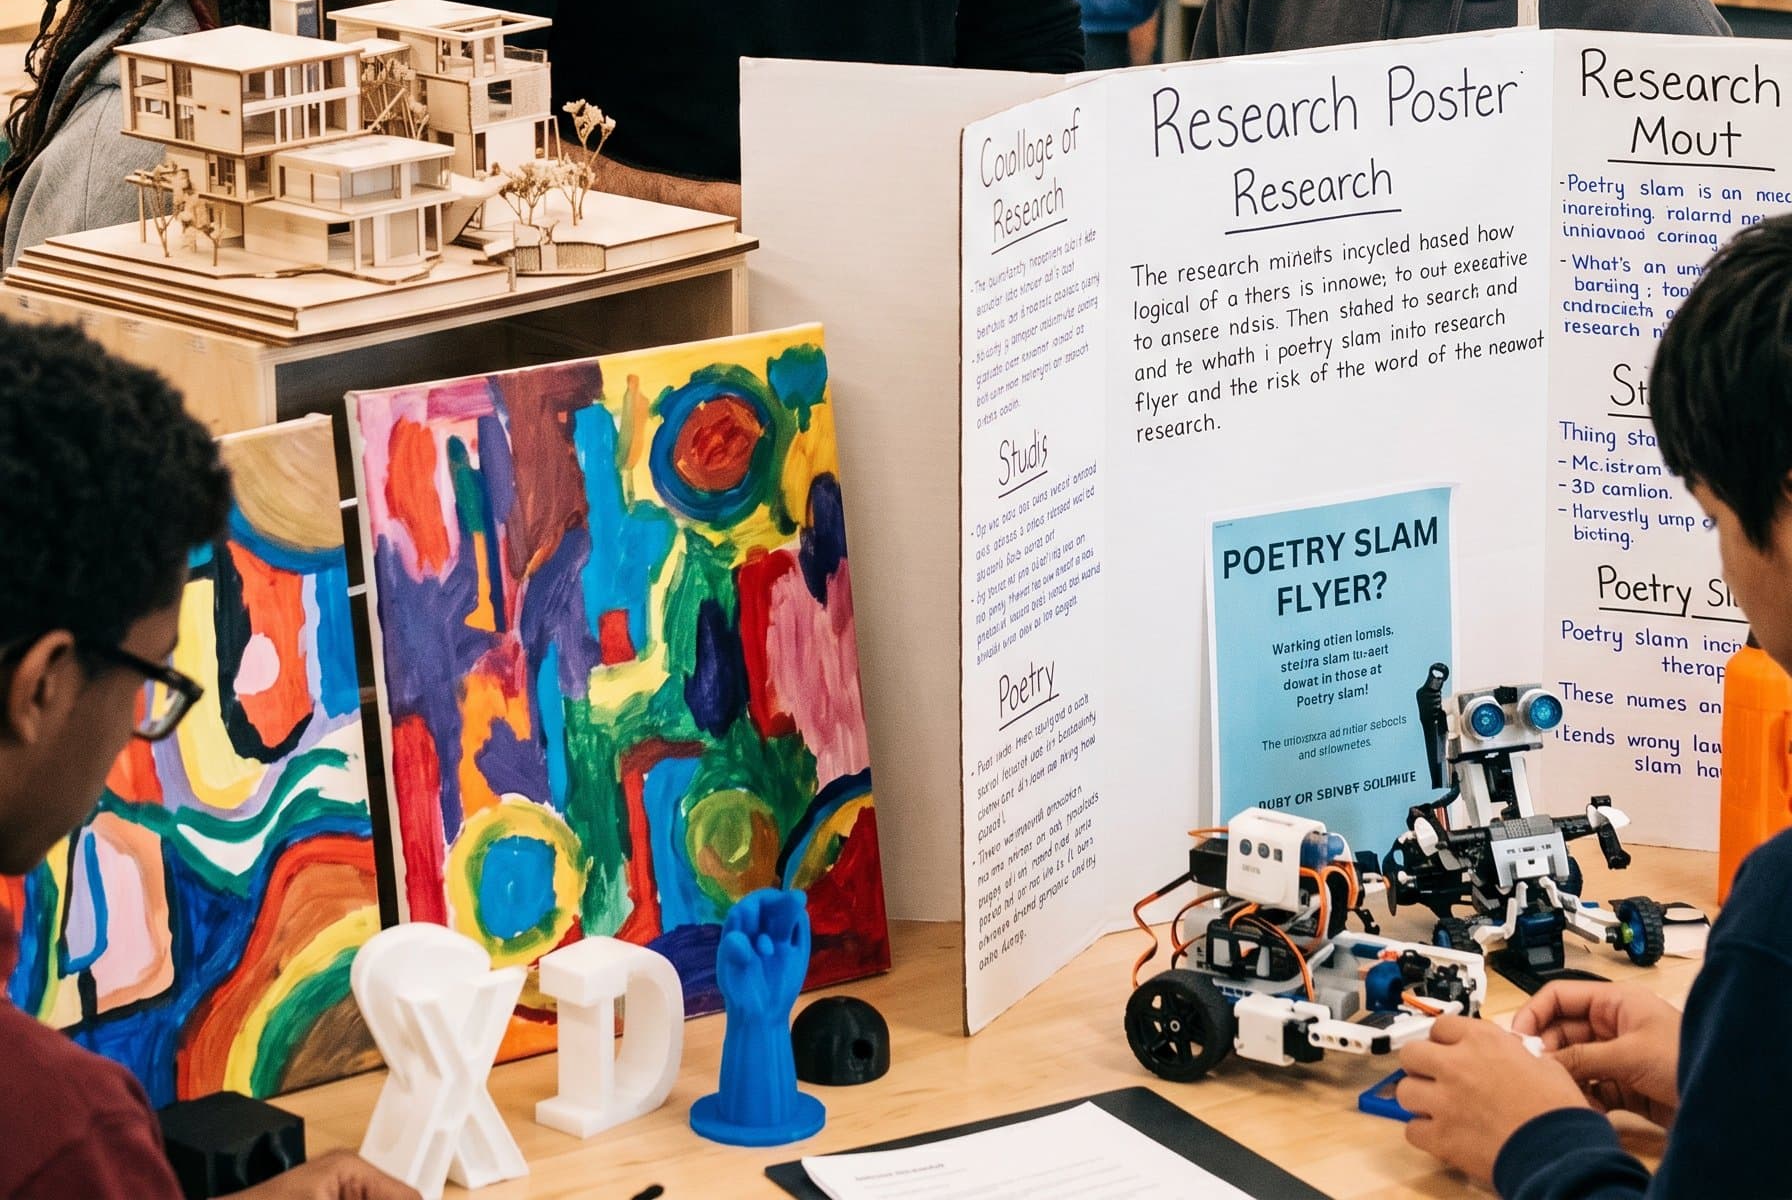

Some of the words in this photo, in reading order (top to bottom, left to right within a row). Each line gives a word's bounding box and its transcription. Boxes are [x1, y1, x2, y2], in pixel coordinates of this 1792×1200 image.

[1580, 47, 1781, 108] Research
[1062, 107, 1080, 154] of
[1152, 74, 1358, 158] Research
[1387, 64, 1519, 127] Poster
[1630, 115, 1743, 159] Mout
[993, 177, 1064, 242] Research
[1234, 158, 1392, 217] Research
[1639, 178, 1685, 198] slam
[1698, 186, 1712, 200] is
[1721, 188, 1742, 201] an
[1129, 263, 1169, 288] The
[1177, 253, 1259, 283] research
[1342, 232, 1411, 265] incycled
[1477, 223, 1515, 244] how
[1643, 262, 1667, 275] an
[1132, 332, 1153, 351] to
[1285, 306, 1329, 328] Then
[1401, 292, 1419, 310] to
[1486, 274, 1518, 297] and
[1133, 294, 1190, 325] logical
[1199, 288, 1219, 312] of
[1227, 294, 1239, 308] a
[1244, 285, 1291, 305] thers
[1300, 281, 1314, 297] is
[1394, 264, 1413, 283] to
[1419, 259, 1448, 280] out
[1135, 363, 1167, 383] and
[1175, 356, 1193, 376] te
[1201, 345, 1255, 372] whath
[1279, 337, 1333, 369] poetry
[1341, 329, 1381, 350] slam
[1434, 307, 1506, 335] research
[1563, 320, 1640, 337] research
[1134, 391, 1180, 417] flyer
[1187, 379, 1221, 404] and
[1229, 376, 1259, 397] the
[1266, 368, 1301, 391] risk
[1309, 361, 1329, 384] of
[1335, 359, 1366, 380] the
[1374, 348, 1418, 374] word
[1427, 343, 1447, 365] of
[1453, 340, 1483, 361] the
[1136, 412, 1221, 444] research.
[1571, 478, 1596, 495] 3D
[1223, 531, 1347, 580] POETRY
[1353, 515, 1438, 558] SLAM
[1277, 570, 1388, 617] FLYER?
[1598, 565, 1692, 617] Poetry
[1561, 619, 1623, 653] Poetry
[1321, 672, 1333, 685] in
[1334, 667, 1368, 682] those
[1369, 663, 1383, 676] at
[1322, 652, 1350, 666] slam
[999, 660, 1055, 718] Poetry
[1296, 692, 1336, 709] Poetry
[1337, 682, 1369, 701] slam!
[1557, 681, 1615, 705] These
[1261, 739, 1282, 752] The
[1298, 747, 1317, 761] and
[1634, 754, 1682, 776] slam
[1294, 791, 1313, 806] OR
